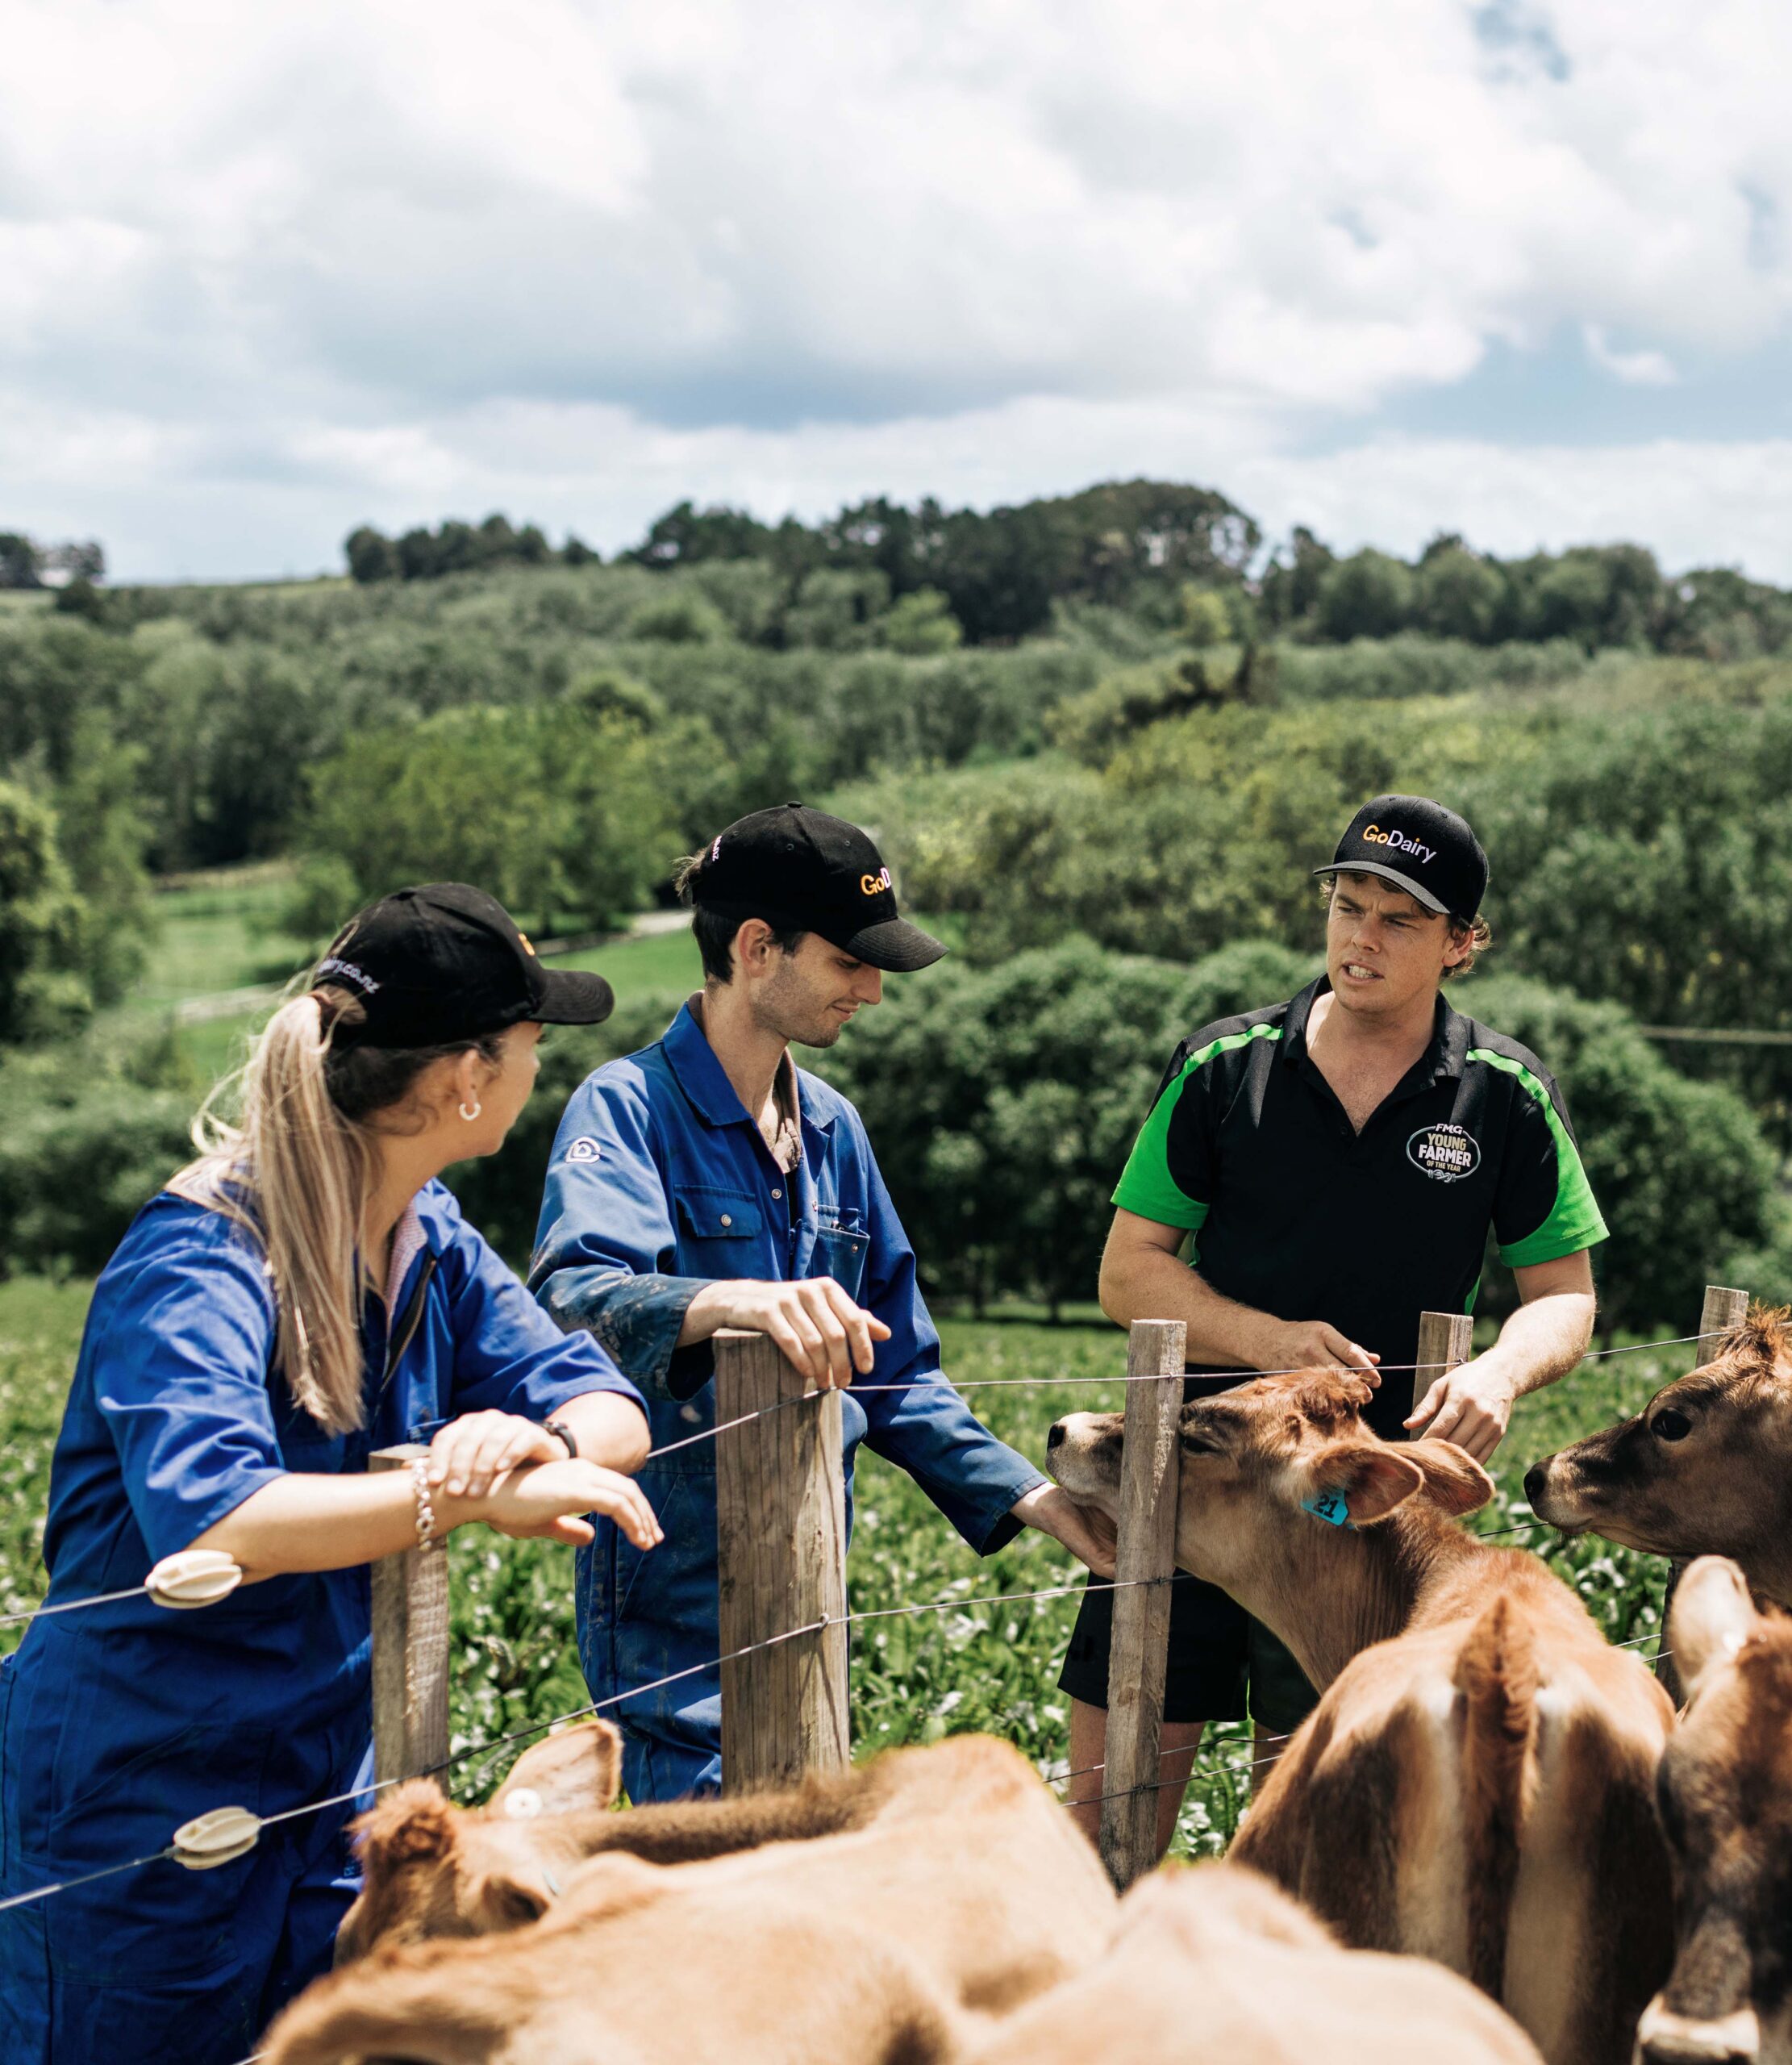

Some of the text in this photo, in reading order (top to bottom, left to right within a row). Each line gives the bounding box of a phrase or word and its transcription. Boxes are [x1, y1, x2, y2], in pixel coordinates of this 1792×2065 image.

[1362, 824, 1437, 864] GoDairy
[1435, 1123, 1463, 1135] FMG
[1427, 1133, 1466, 1151] YOUNG
[1418, 1144, 1472, 1167] FARMER
[1435, 1161, 1446, 1170] THE
[1447, 1163, 1461, 1172] YEAR
[1313, 1494, 1339, 1519] 21
